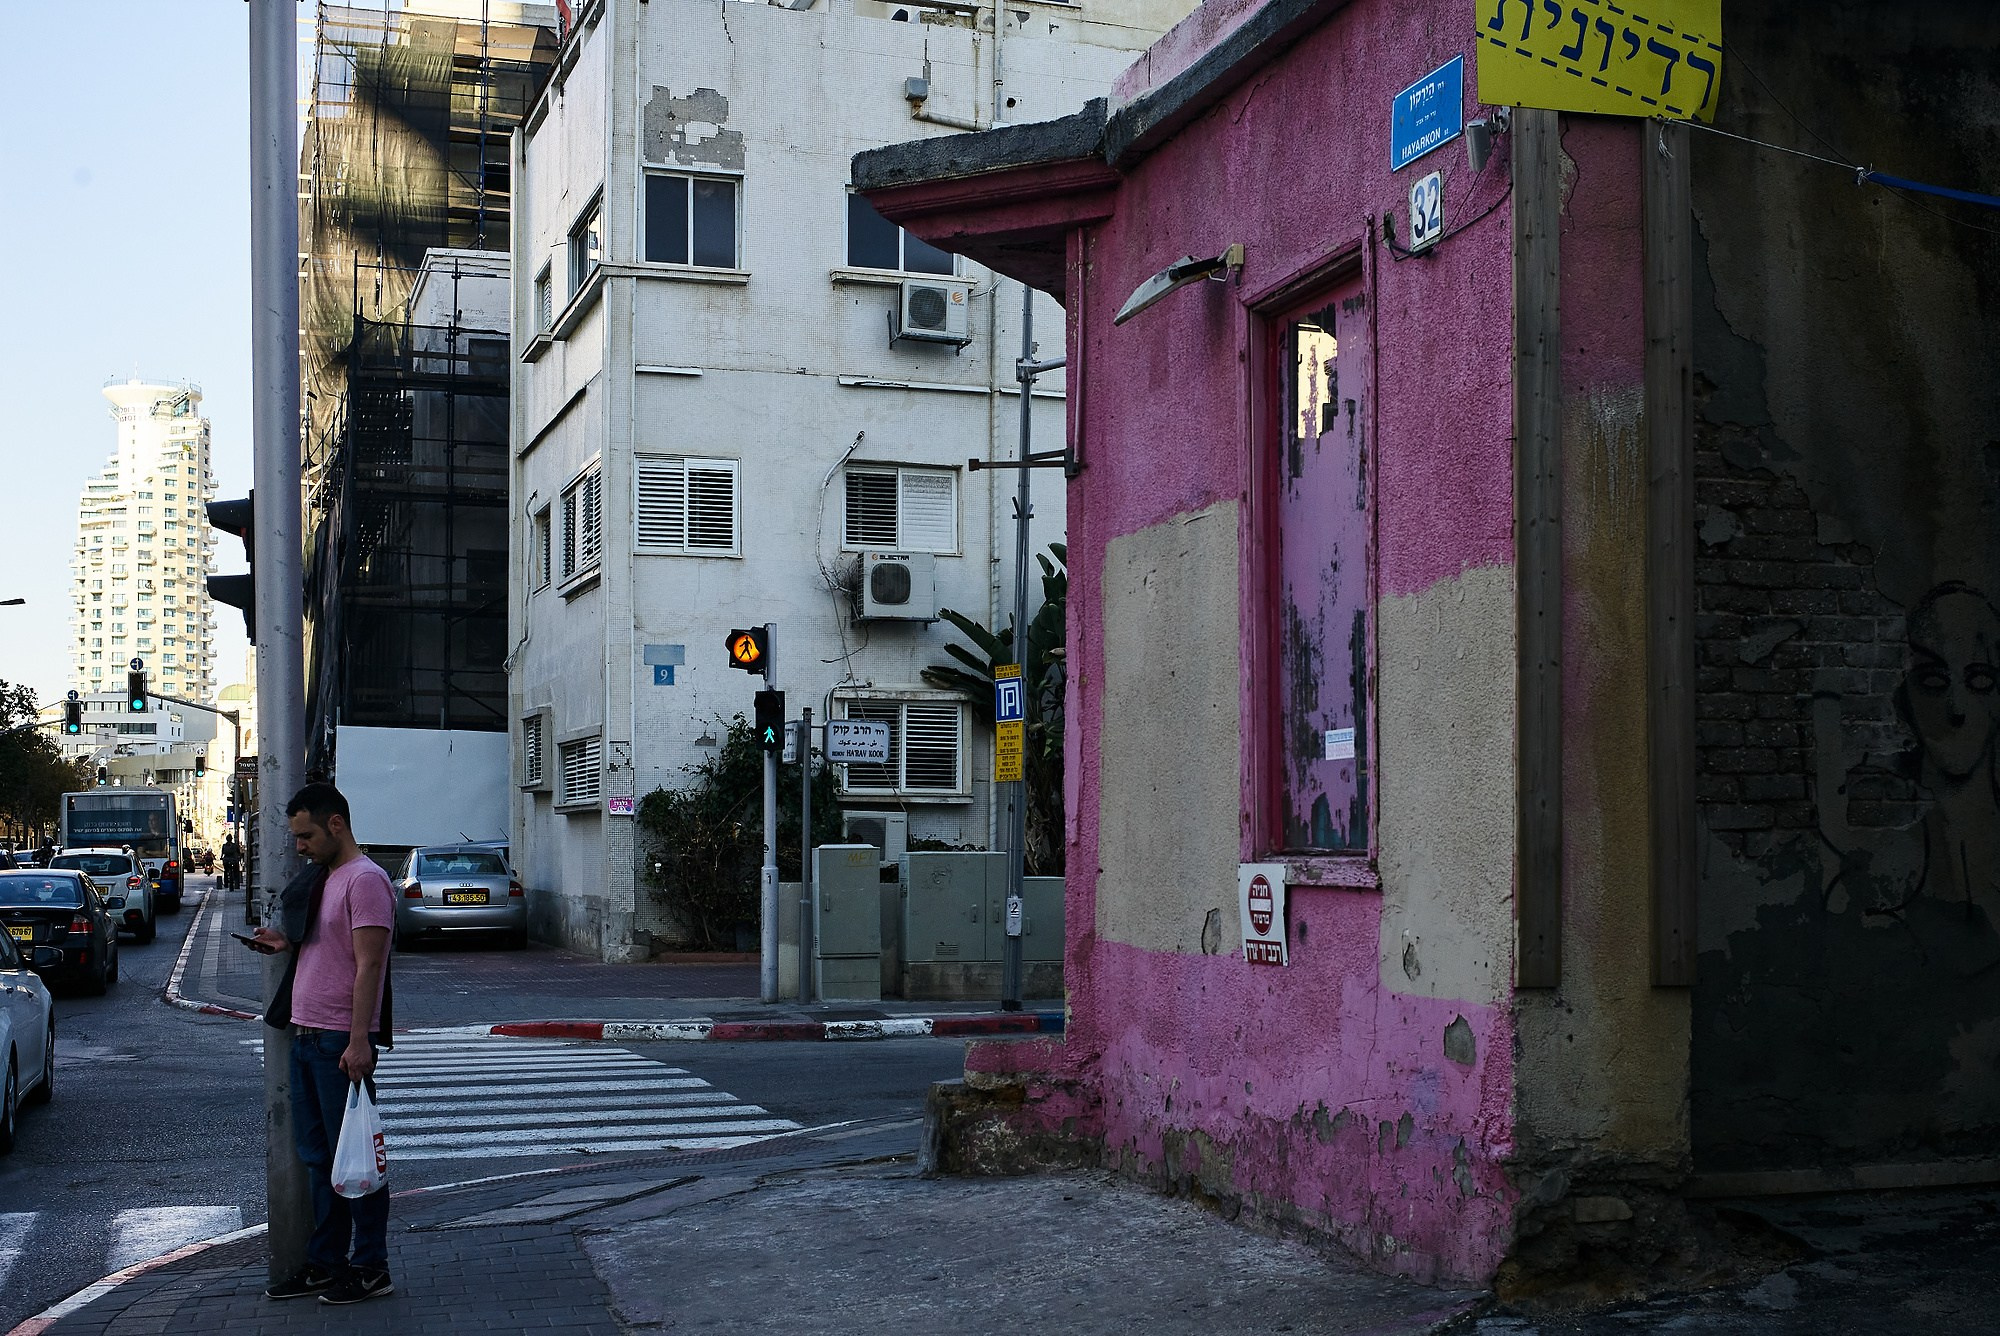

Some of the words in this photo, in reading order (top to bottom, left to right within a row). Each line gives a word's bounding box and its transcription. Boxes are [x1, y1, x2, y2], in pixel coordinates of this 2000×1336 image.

[1402, 127, 1441, 160] HAYARKON
[1414, 177, 1440, 239] 32
[660, 669, 668, 681] 9
[832, 725, 850, 736] קוק
[853, 725, 872, 735] הרב
[1252, 885, 1268, 896] חניה
[1253, 914, 1269, 924] פרטית
